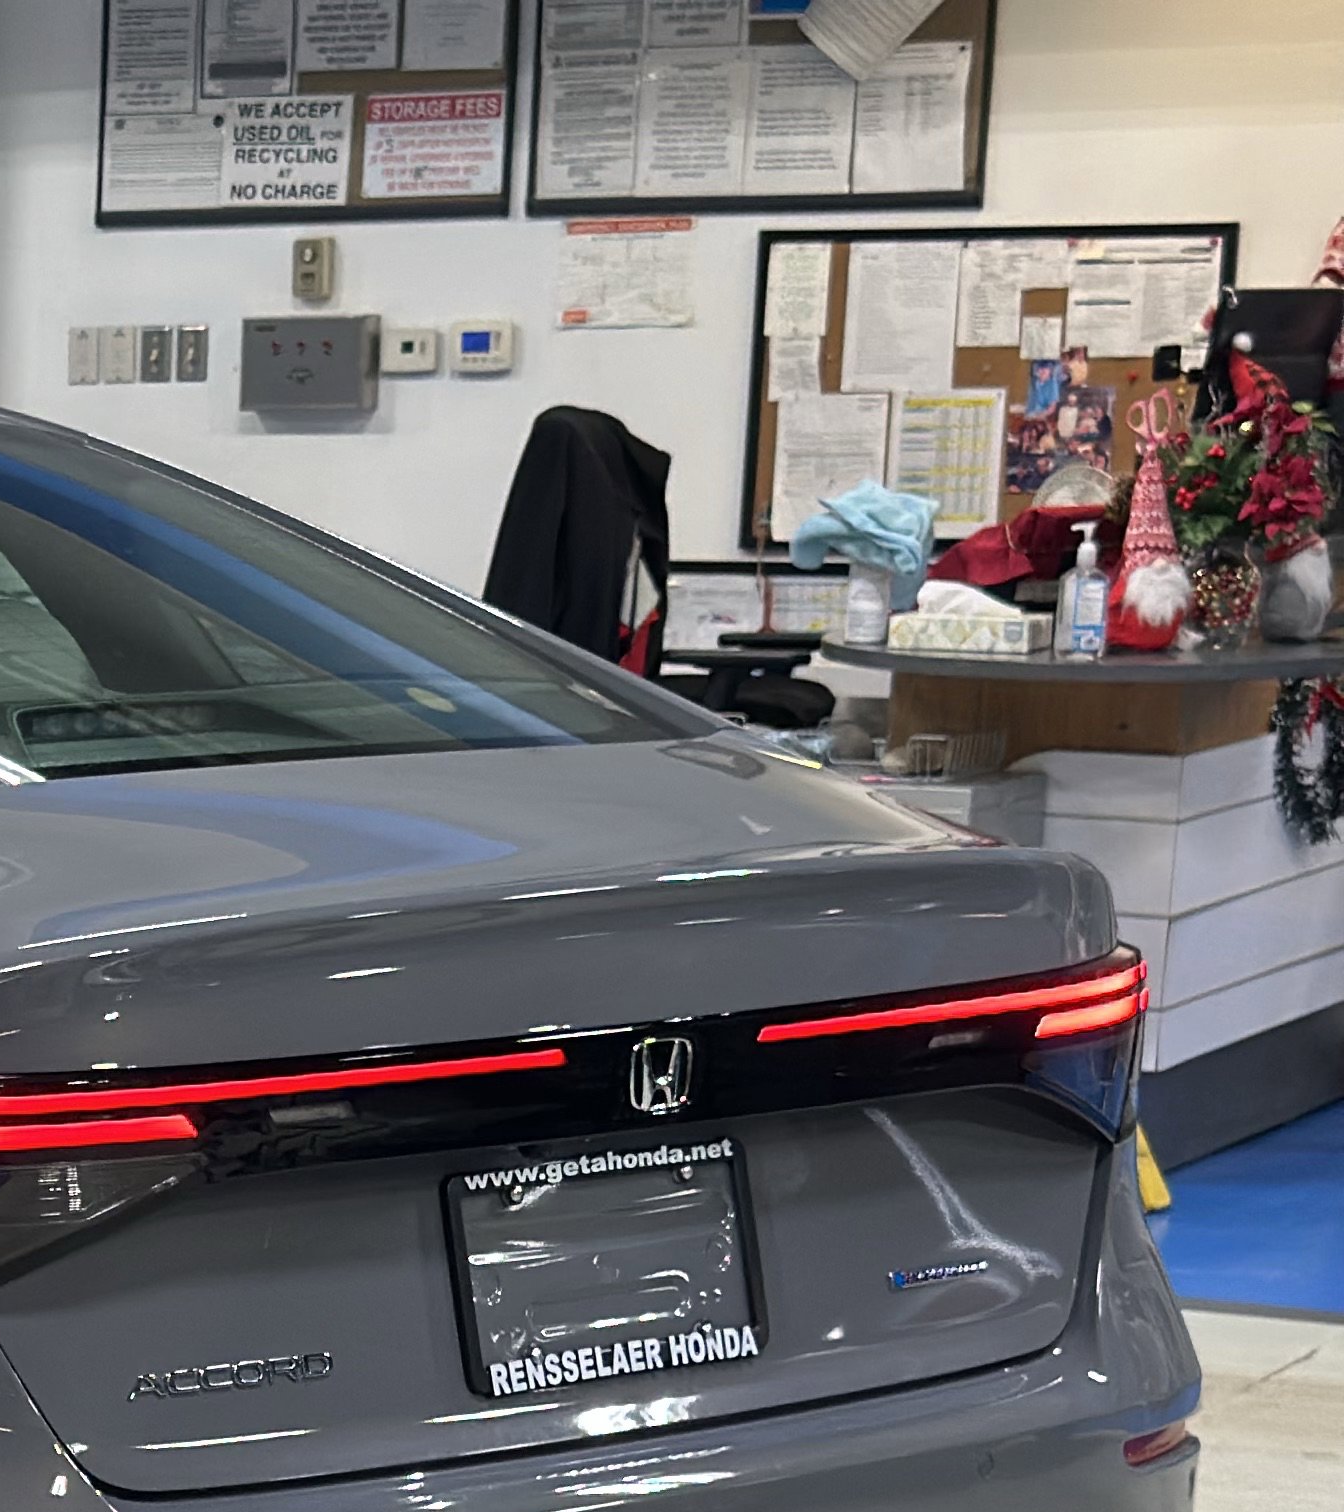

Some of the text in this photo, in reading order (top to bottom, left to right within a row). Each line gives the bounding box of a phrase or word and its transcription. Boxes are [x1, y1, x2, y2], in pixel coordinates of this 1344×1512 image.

[238, 102, 343, 119] WE ACCEPT
[370, 97, 500, 121] STORAGE FEES
[233, 125, 282, 142] USED
[286, 124, 315, 141] OIL
[234, 148, 338, 164] RECYCLING
[230, 183, 338, 200] NO CHARGE
[464, 1138, 734, 1192] www.getahonda.net
[489, 1325, 759, 1397] RENSSELAER HONDA
[127, 1351, 334, 1402] ACCORD
